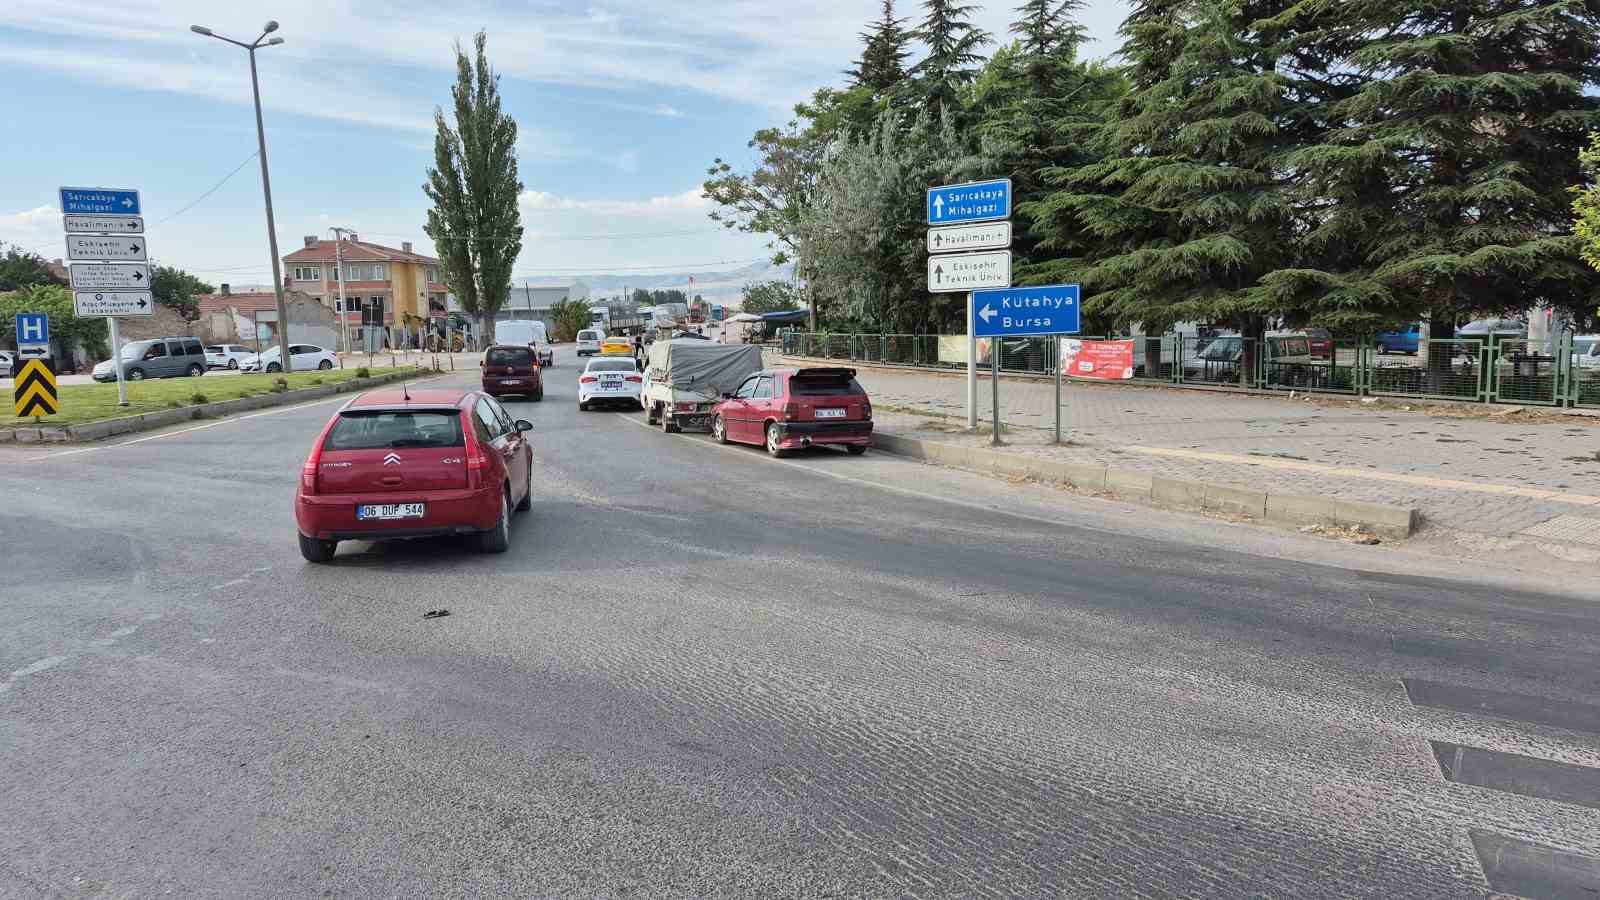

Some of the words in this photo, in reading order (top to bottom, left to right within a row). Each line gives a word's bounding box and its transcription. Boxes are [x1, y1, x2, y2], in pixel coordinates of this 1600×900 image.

[948, 203, 998, 216] Mihalgazi
[1002, 294, 1074, 310] Kütahya
[22, 317, 42, 340] H
[1002, 316, 1052, 328] Bursa
[364, 505, 377, 517] 06
[404, 503, 423, 515] 544
